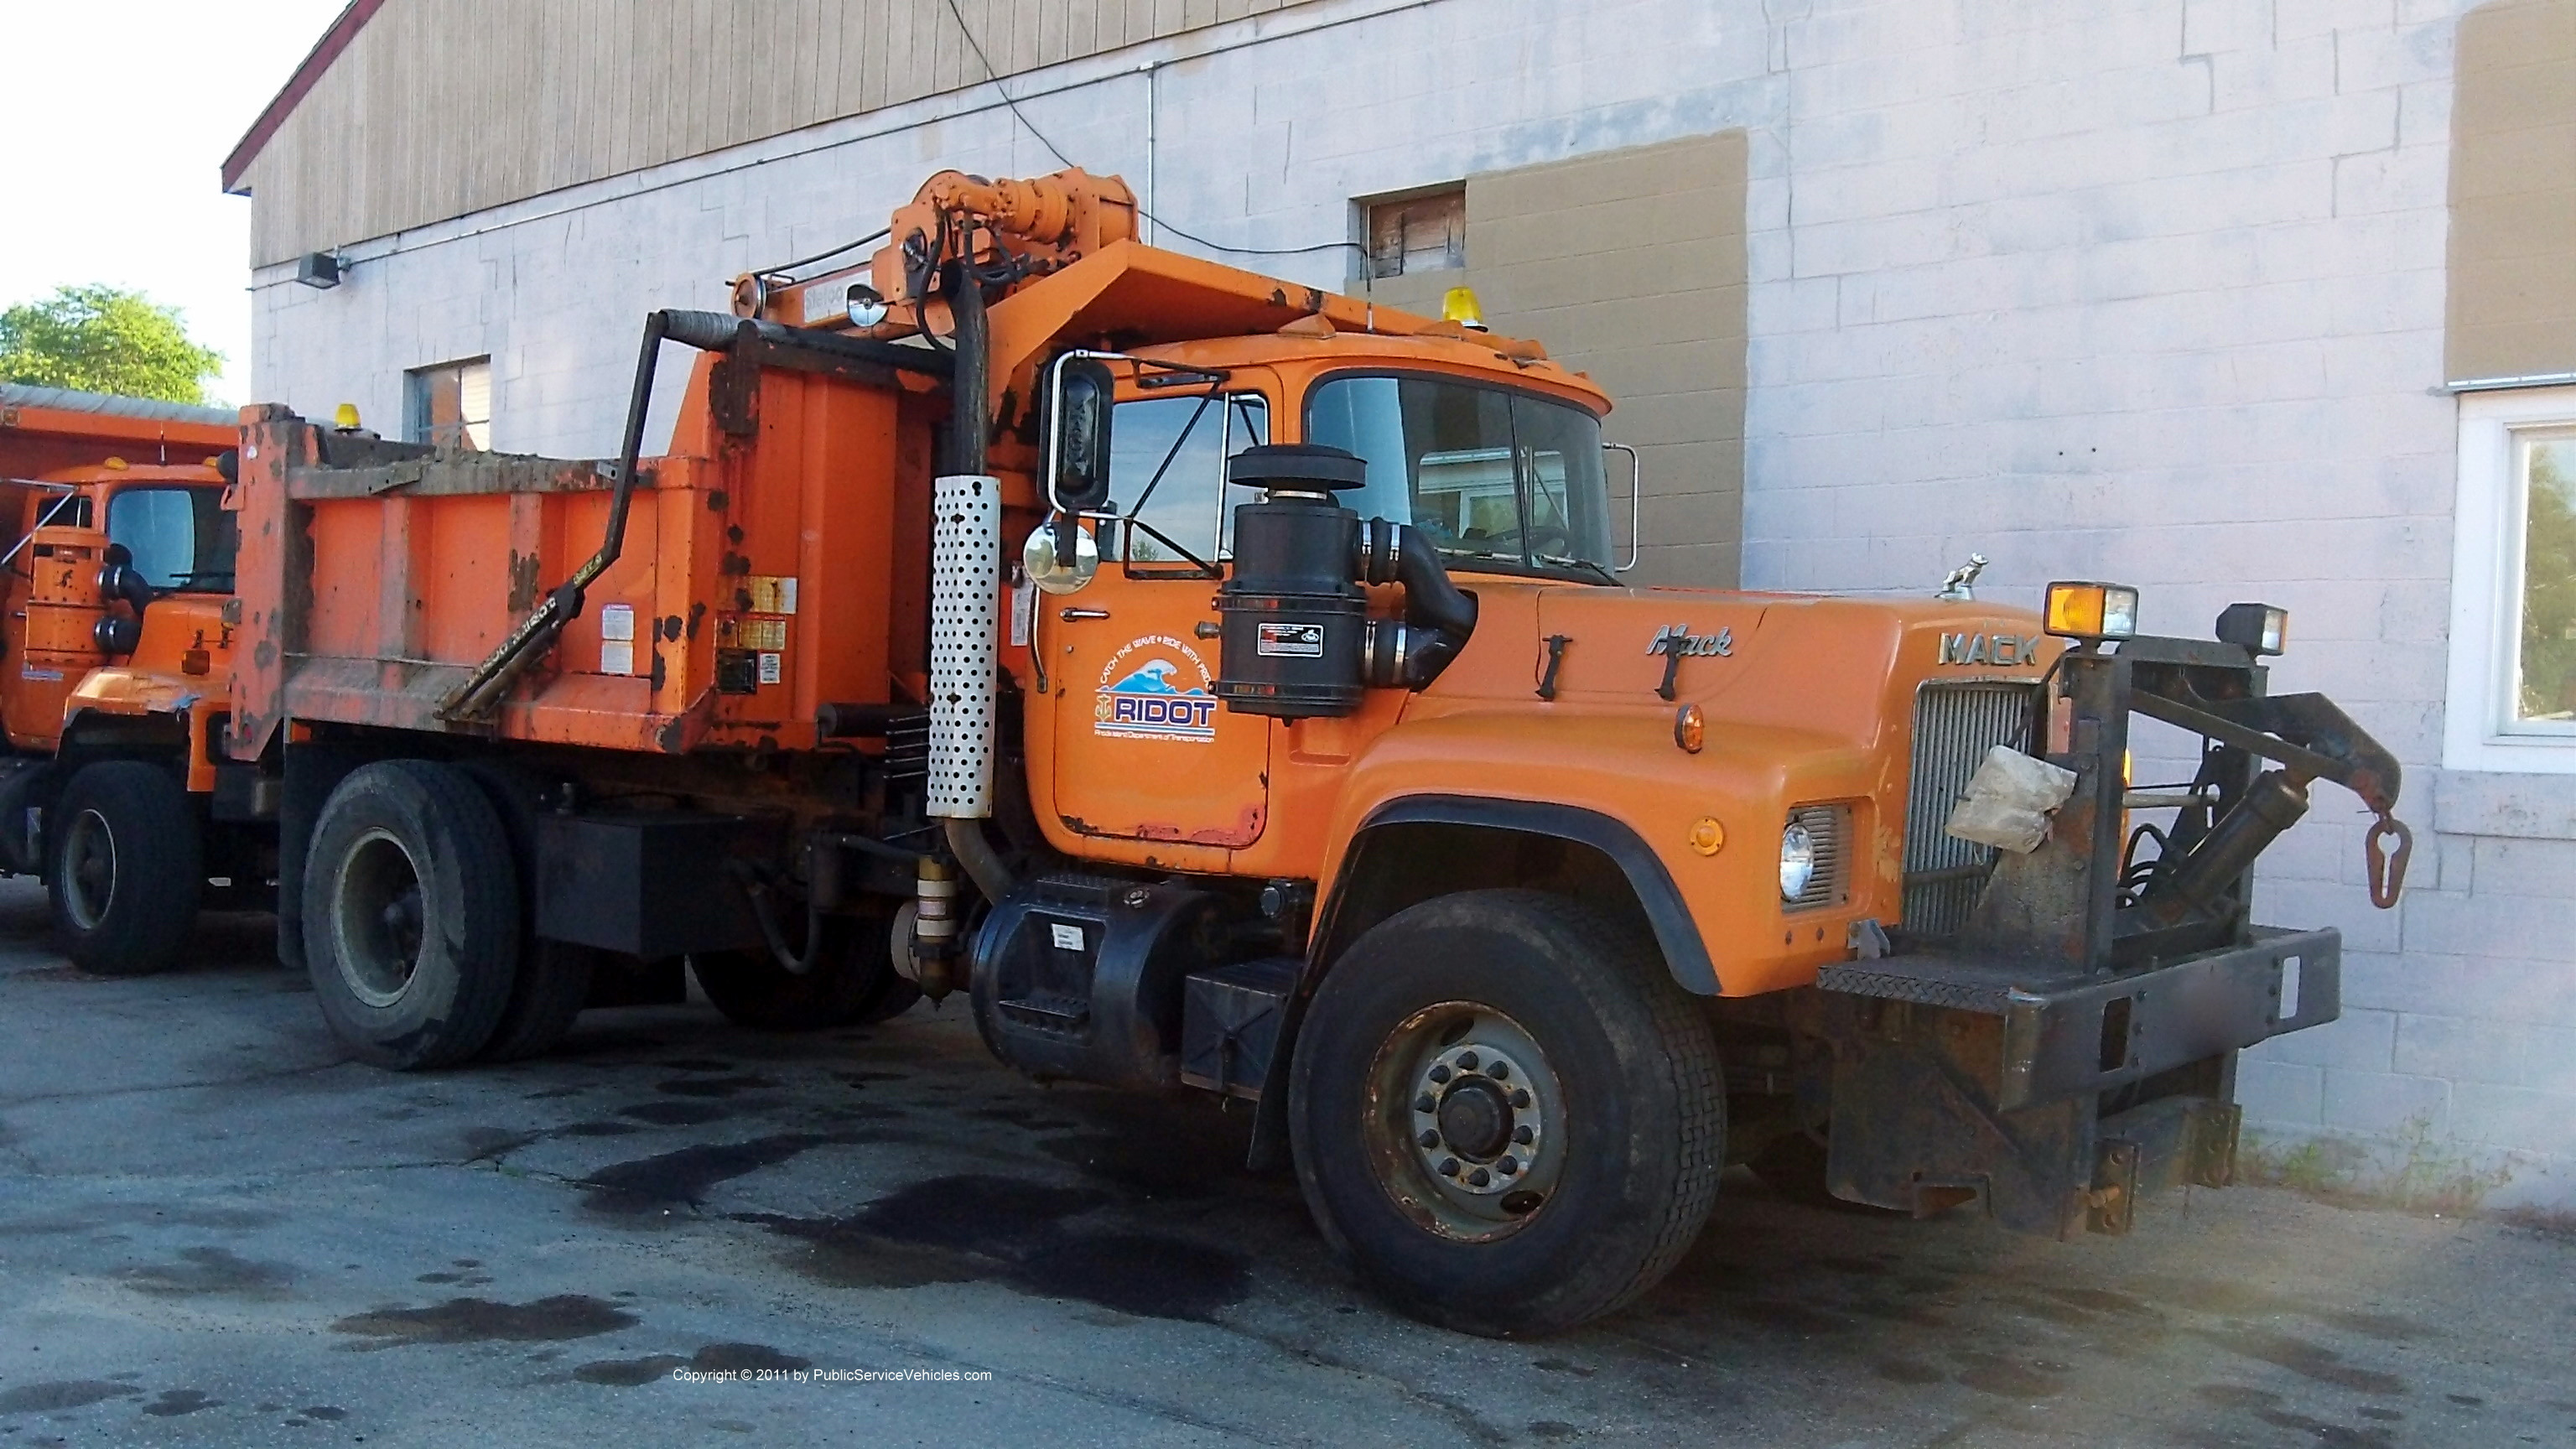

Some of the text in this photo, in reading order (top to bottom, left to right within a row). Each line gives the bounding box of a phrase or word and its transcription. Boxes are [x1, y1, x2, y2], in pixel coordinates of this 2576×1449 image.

[1645, 624, 1732, 657] Mack
[1939, 632, 2039, 666] MACK
[1099, 656, 1119, 684] CATCH
[1116, 643, 1133, 659] THE
[1132, 635, 1156, 649] WAVE
[1162, 636, 1182, 650] RIDE
[1182, 643, 1202, 665] WITH
[1114, 697, 1217, 727] RIDOT
